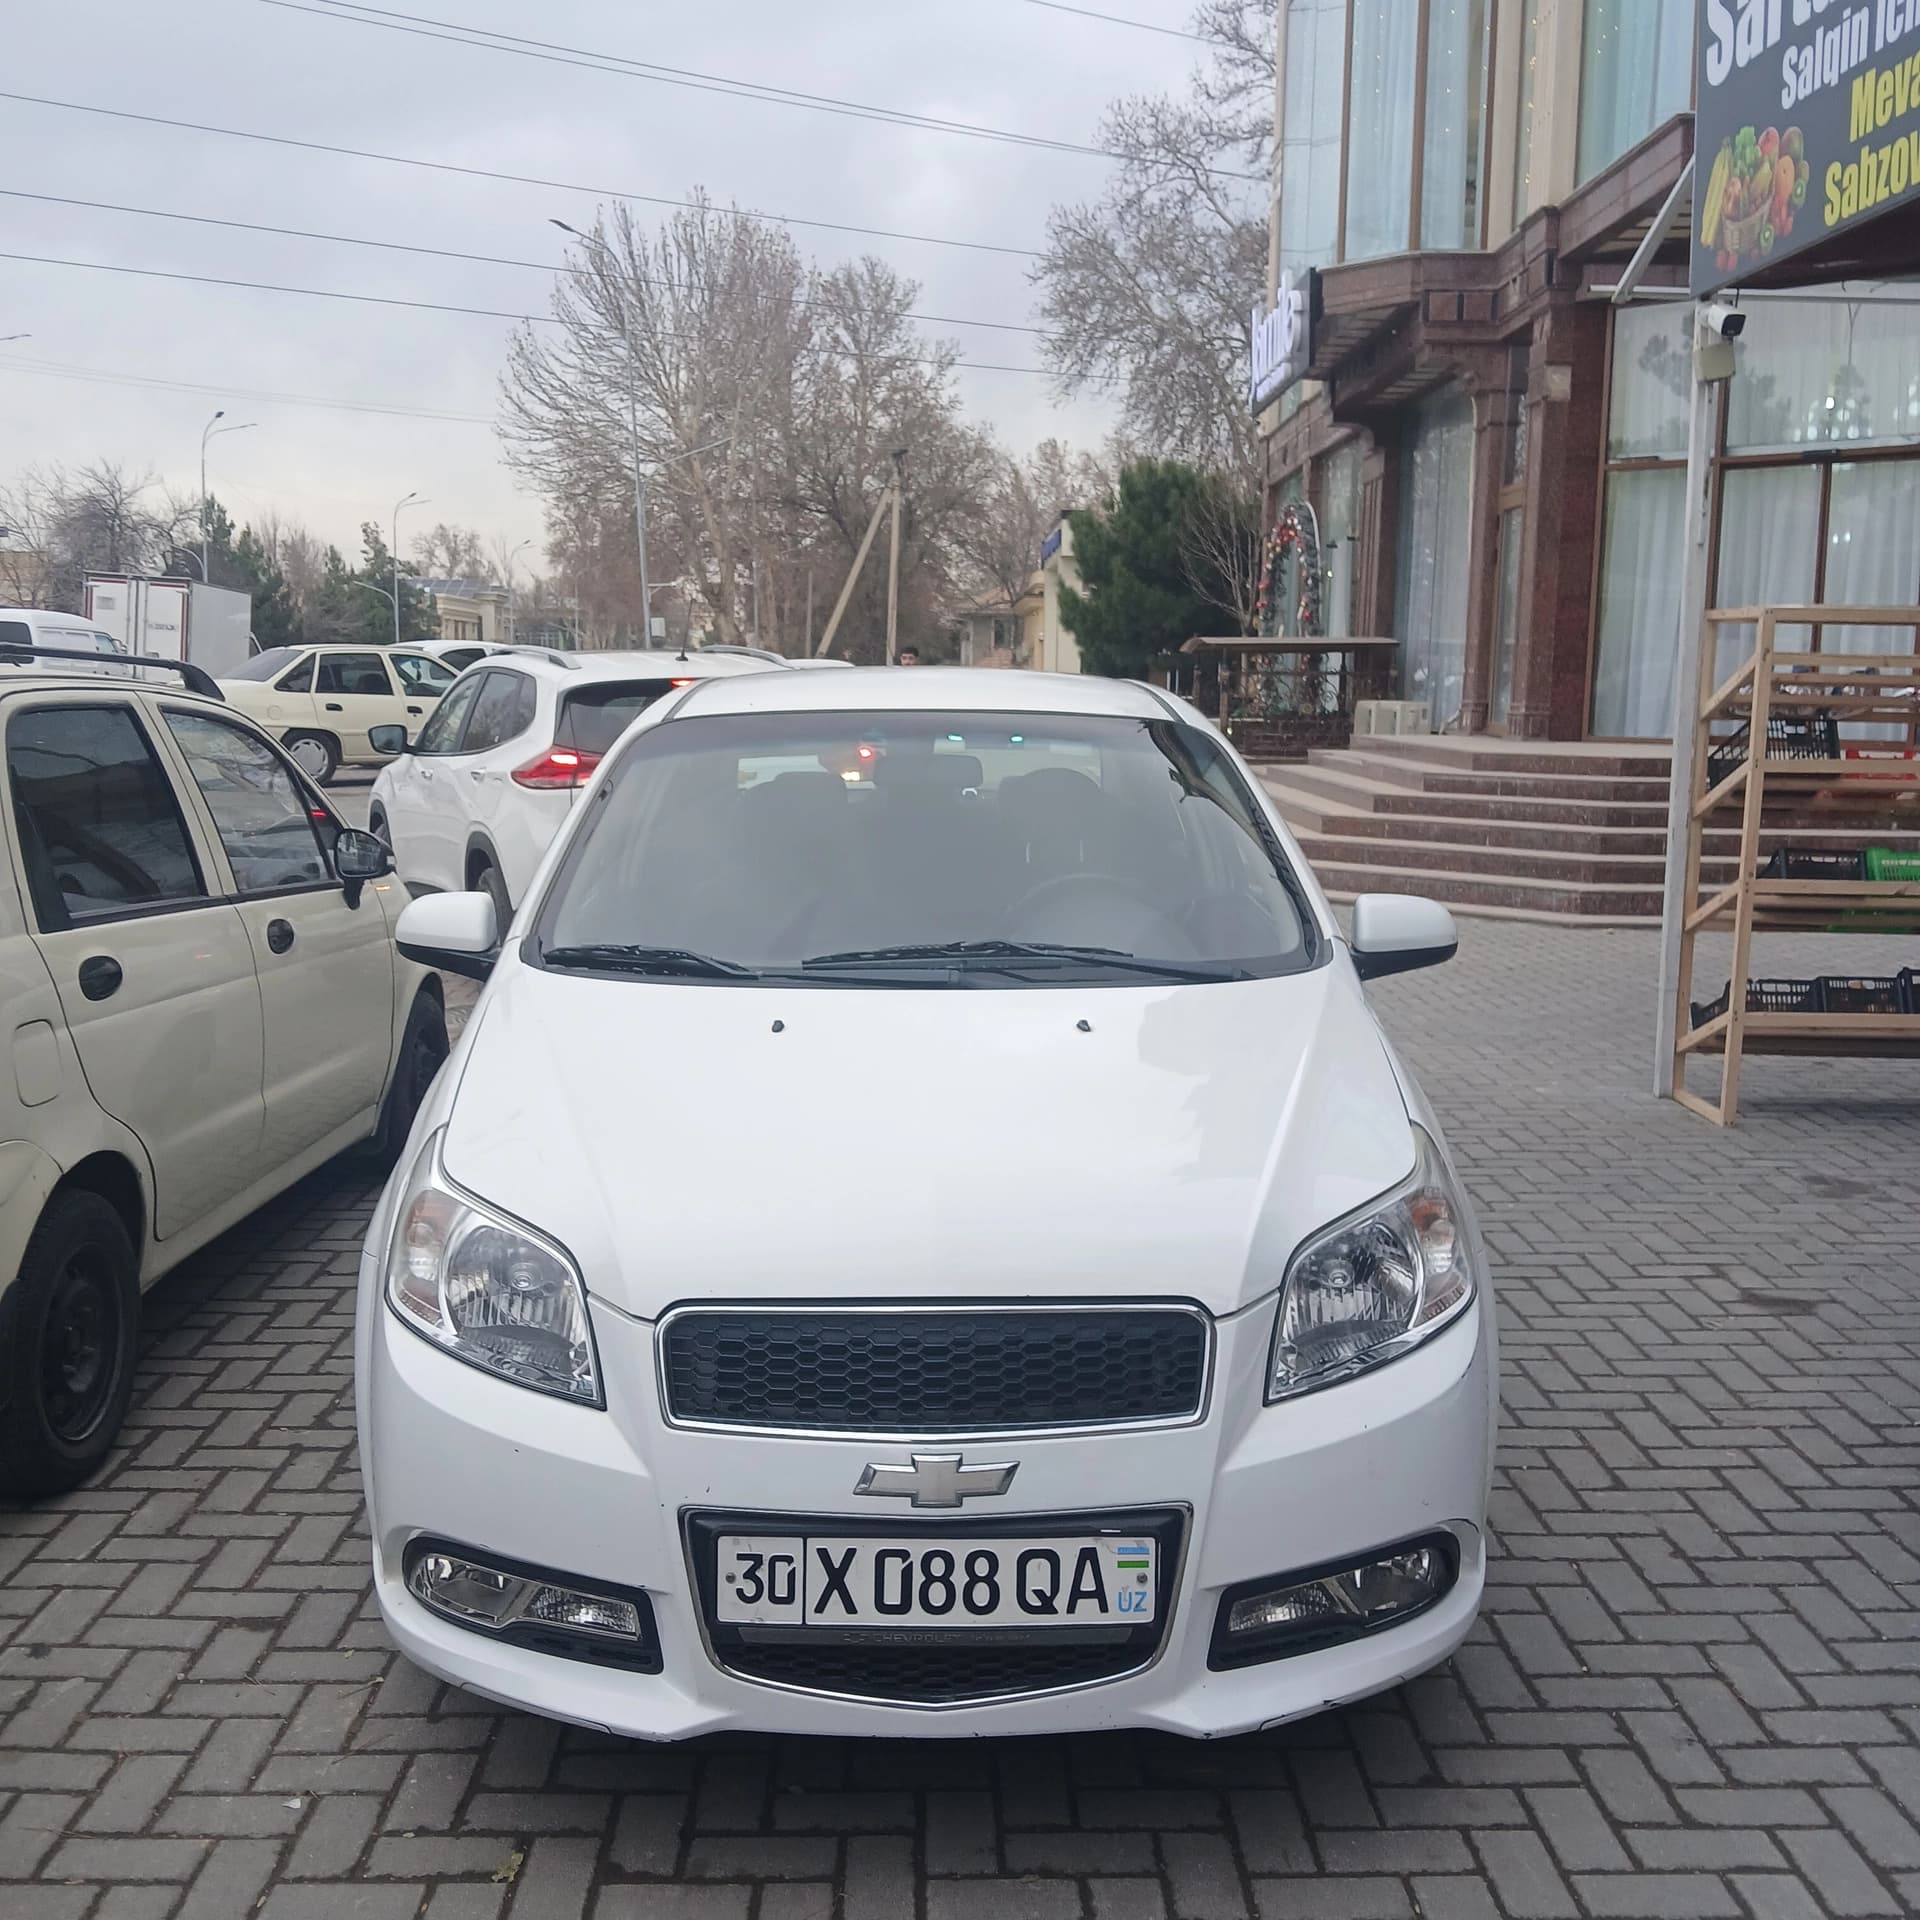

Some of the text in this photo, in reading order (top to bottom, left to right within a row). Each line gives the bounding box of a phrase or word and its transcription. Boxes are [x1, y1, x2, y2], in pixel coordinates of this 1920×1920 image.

[1781, 6, 1869, 109] Salqin
[735, 1546, 1109, 1615] 30 X 088 QA
[1118, 1591, 1147, 1612] UZ
